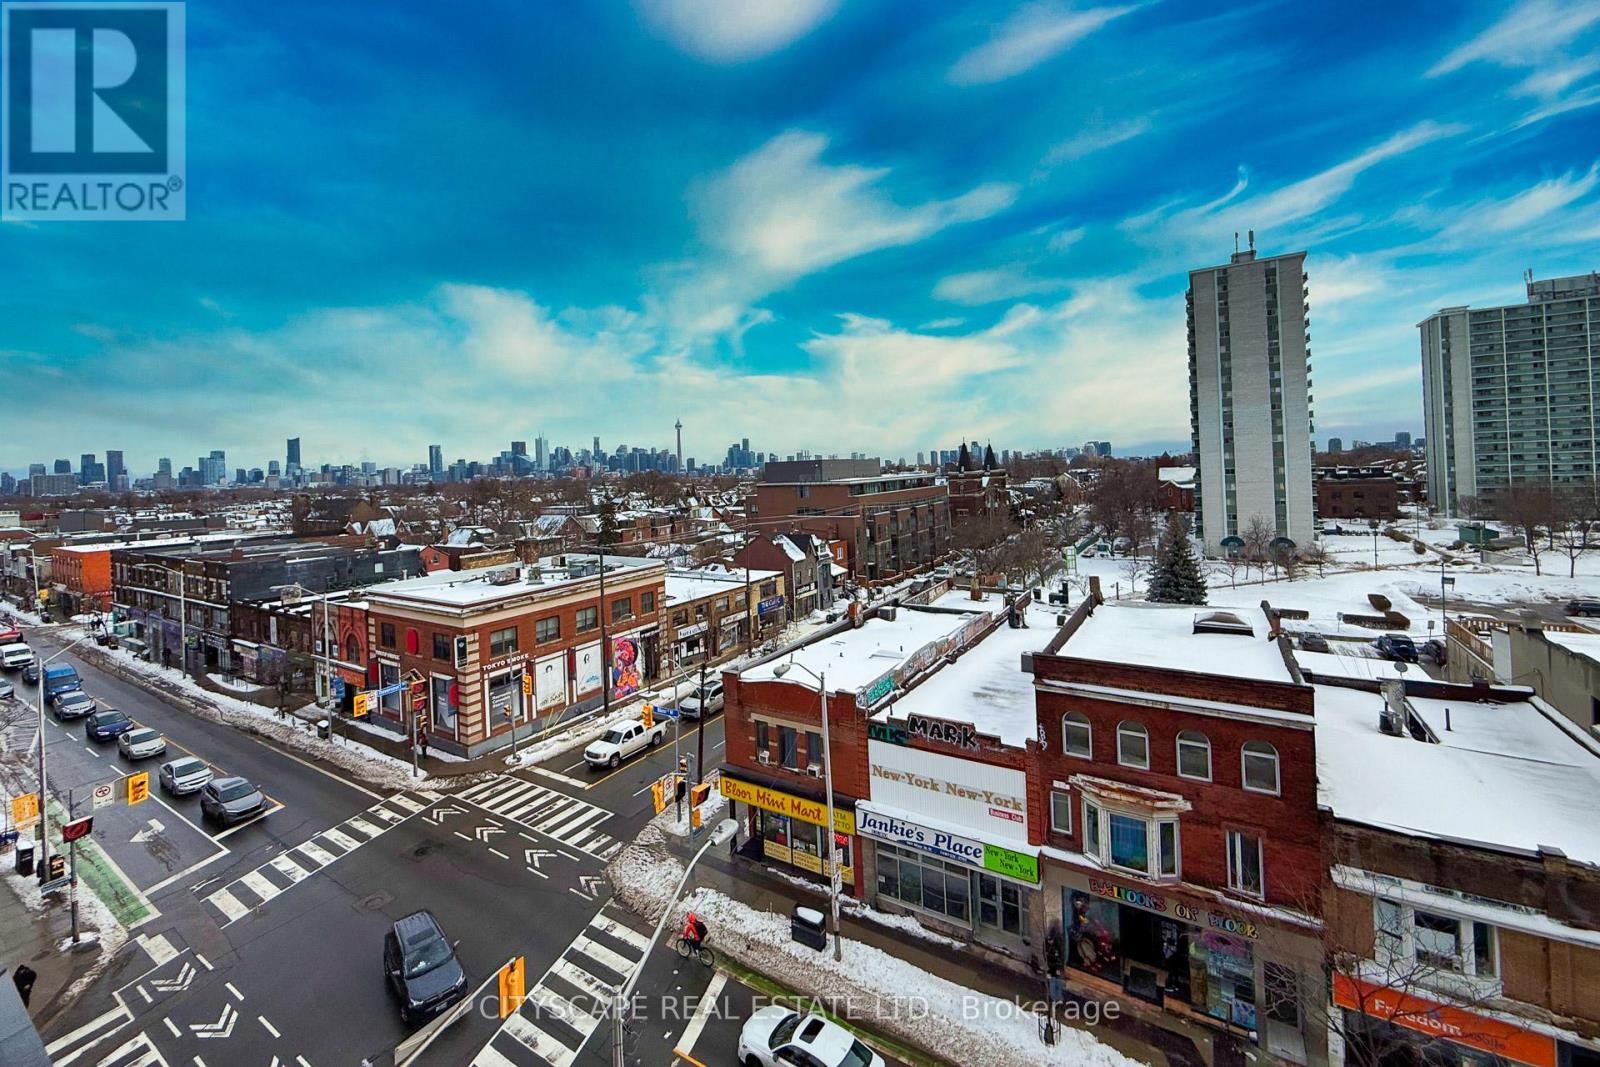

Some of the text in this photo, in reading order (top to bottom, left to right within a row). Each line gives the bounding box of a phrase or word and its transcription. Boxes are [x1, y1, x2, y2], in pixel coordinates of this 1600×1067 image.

[483, 660, 506, 672] TOKYO
[907, 714, 981, 751] MARK
[724, 780, 823, 821] Bloor Mini Mart
[872, 765, 1023, 811] New-York New-York
[859, 811, 924, 842] Jankie's
[934, 832, 983, 859] Place
[1174, 903, 1200, 921] ON
